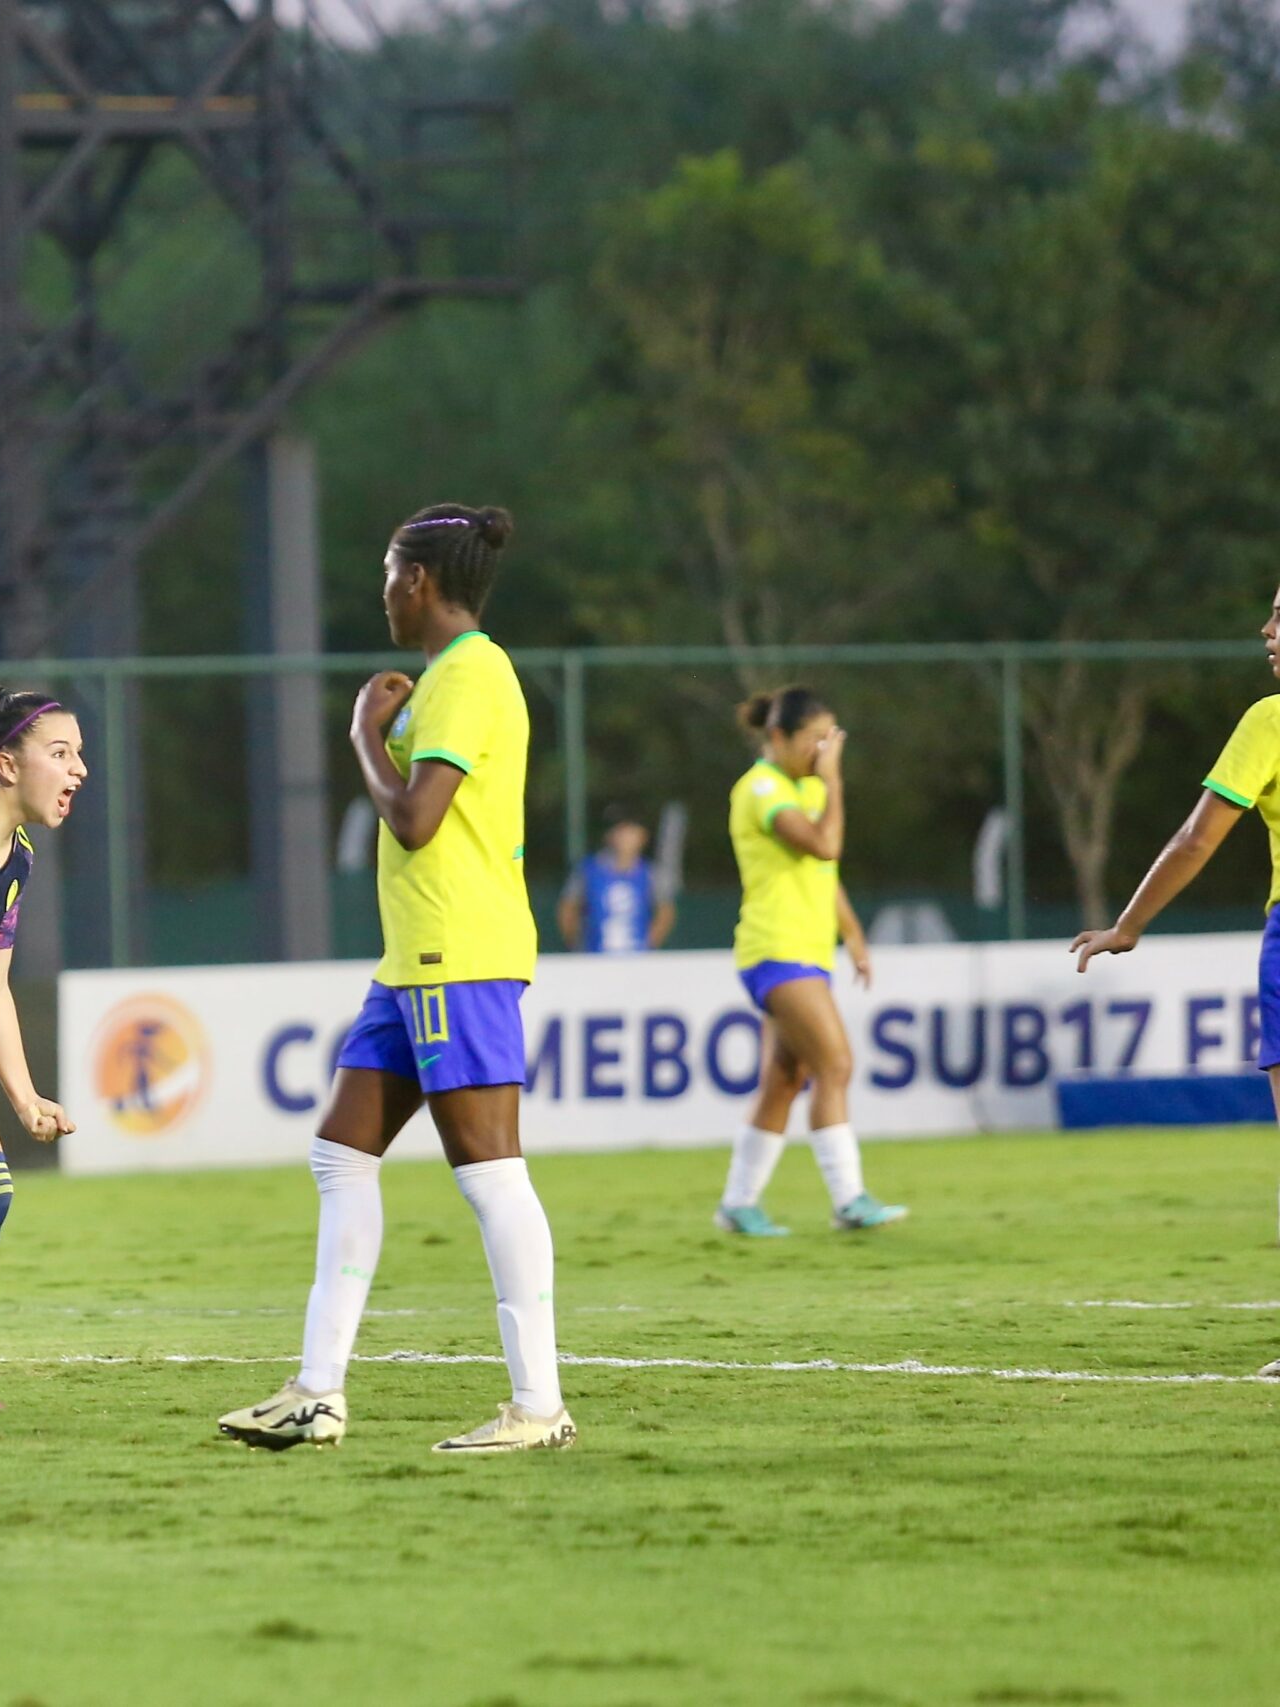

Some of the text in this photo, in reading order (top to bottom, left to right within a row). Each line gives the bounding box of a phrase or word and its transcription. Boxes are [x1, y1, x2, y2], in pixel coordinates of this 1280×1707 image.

[261, 1010, 812, 1112] CMEBO
[870, 998, 1152, 1089] SUB17
[407, 985, 450, 1044] 10
